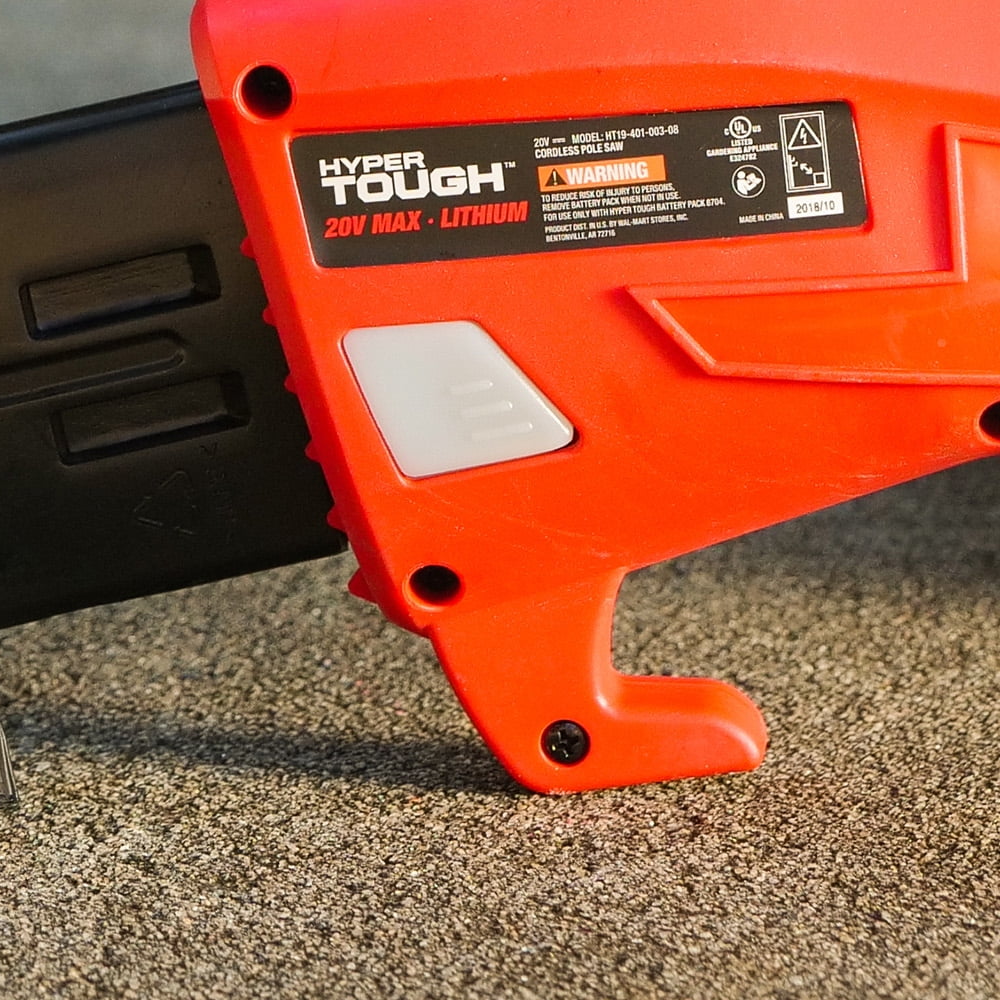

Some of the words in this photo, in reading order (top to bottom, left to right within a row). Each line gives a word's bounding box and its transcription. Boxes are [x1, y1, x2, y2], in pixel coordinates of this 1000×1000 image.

[533, 137, 549, 148] 20V
[572, 132, 604, 144] MODEL:
[605, 124, 679, 140] HT19-401-003-08
[731, 138, 753, 147] LISTED
[535, 146, 580, 159] CORDLESS
[580, 144, 602, 155] POLE
[604, 142, 624, 152] SAW
[706, 147, 742, 157] GARDENING
[743, 142, 779, 153] APPLIANCE
[319, 151, 425, 177] HYPER
[566, 161, 648, 186] WARNING
[321, 162, 505, 205] TOUGH
[541, 194, 550, 202] TO
[552, 192, 578, 202] REDUCE
[579, 191, 595, 200] RISK
[596, 190, 605, 198] OF
[606, 187, 630, 196] INJURY
[631, 186, 640, 194] TO
[542, 202, 570, 212] REMOVE
[571, 198, 601, 209] BATTERY
[602, 196, 620, 206] PACK
[620, 195, 641, 205] WHEN
[642, 194, 656, 202] NOT
[657, 193, 665, 201] IN
[665, 192, 681, 200] USE.
[544, 213, 558, 222] FOR
[558, 212, 572, 220] USE
[572, 210, 590, 219] ONLY
[591, 208, 609, 217] WITH
[610, 206, 632, 216] HYPER
[633, 205, 656, 214] TOUGH
[656, 200, 687, 211] BATTERY
[688, 199, 706, 209] PACK
[796, 200, 835, 214] 2018/10
[324, 214, 366, 238] 20V
[372, 210, 422, 234] MAX
[440, 201, 529, 228] LITHIUM
[544, 224, 572, 234] PRODUCT
[589, 222, 596, 230] IN
[596, 221, 608, 229] U.S.
[618, 217, 649, 227] WAL-MART
[739, 215, 757, 224] MADE
[757, 214, 764, 222] IN
[765, 212, 784, 221] CHINA
[546, 232, 587, 243] BENTONVILLE,
